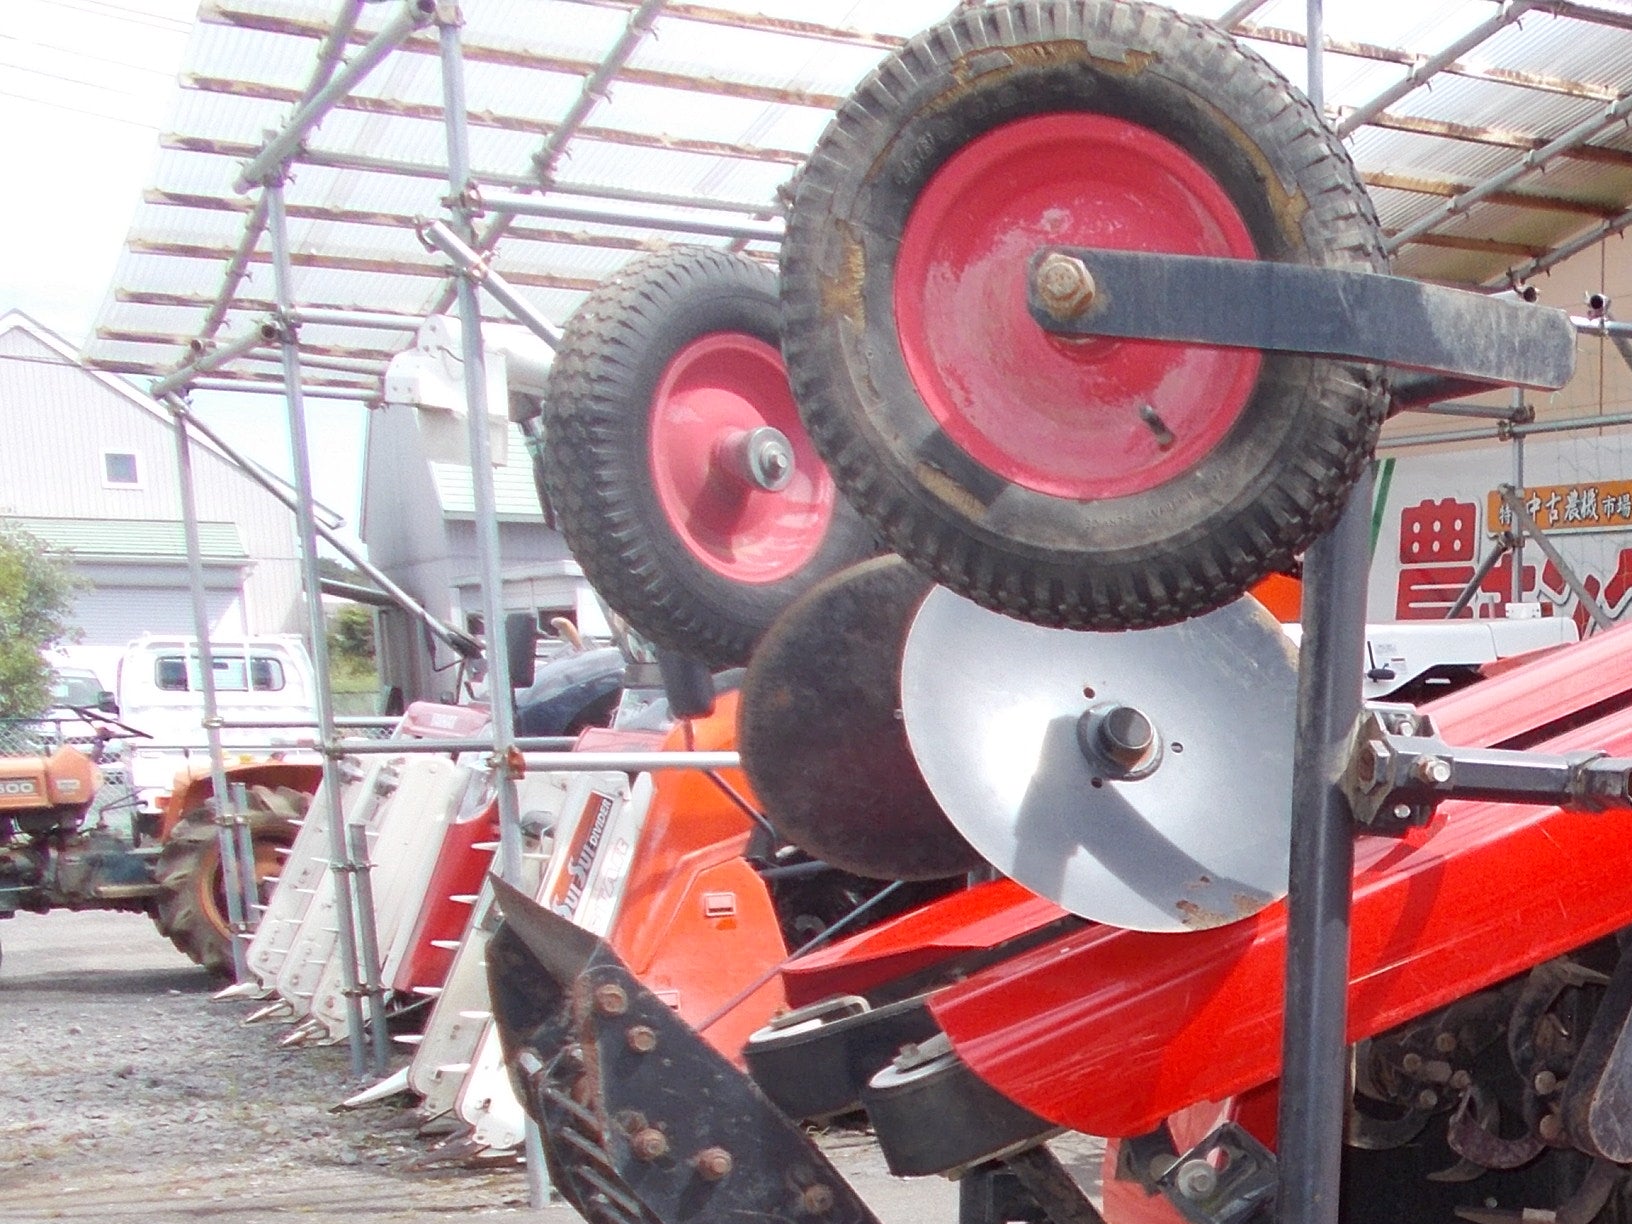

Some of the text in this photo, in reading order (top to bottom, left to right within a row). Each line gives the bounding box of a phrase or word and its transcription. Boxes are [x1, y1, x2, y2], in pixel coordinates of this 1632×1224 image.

[1499, 487, 1632, 527] 特中古農機市場
[589, 798, 613, 847] DIVIDER
